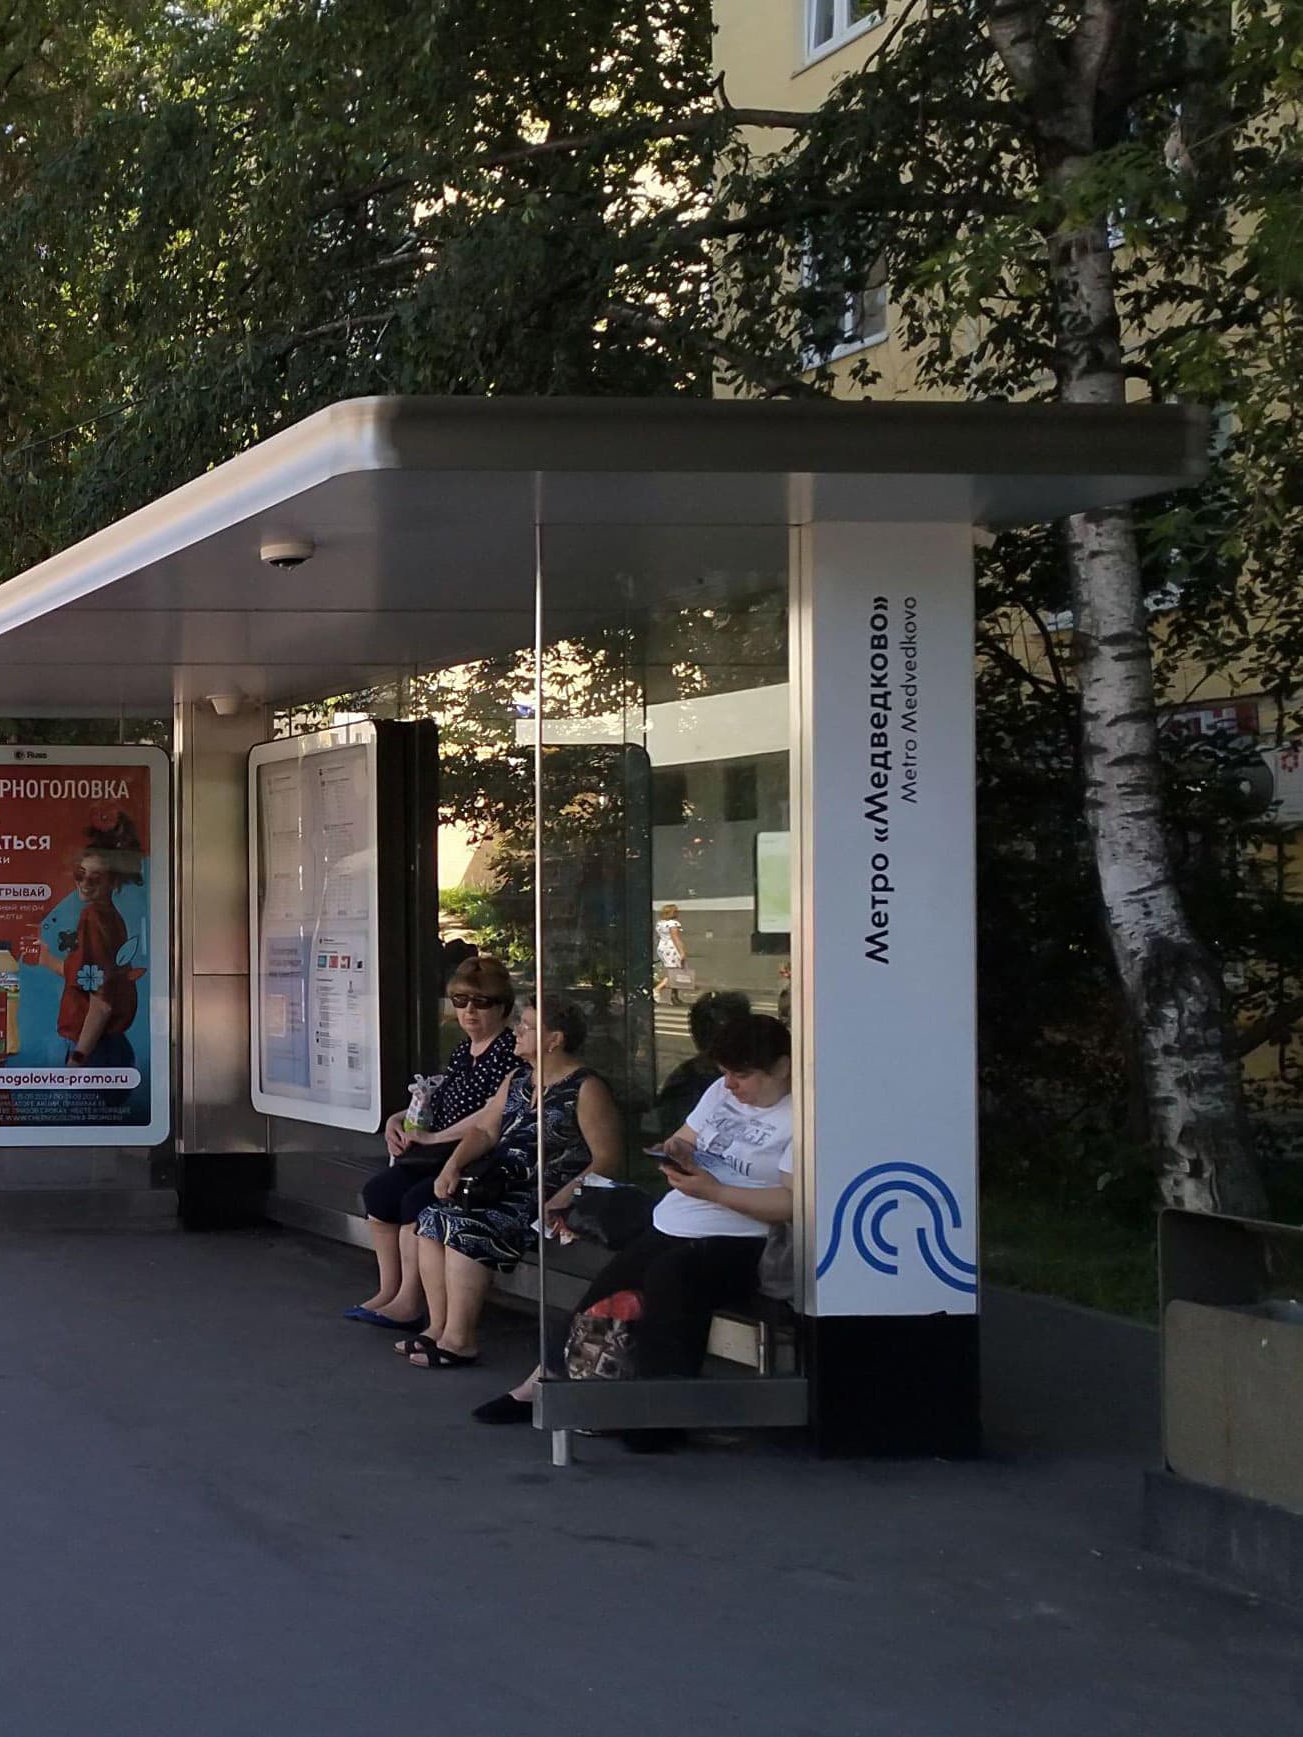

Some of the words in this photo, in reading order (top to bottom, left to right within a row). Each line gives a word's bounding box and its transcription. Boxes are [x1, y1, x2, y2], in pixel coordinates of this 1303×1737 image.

[864, 596, 892, 843] «Медведково»
[899, 596, 918, 733] Medvedkovo
[900, 739, 918, 803] Metro
[864, 853, 894, 965] Метро
